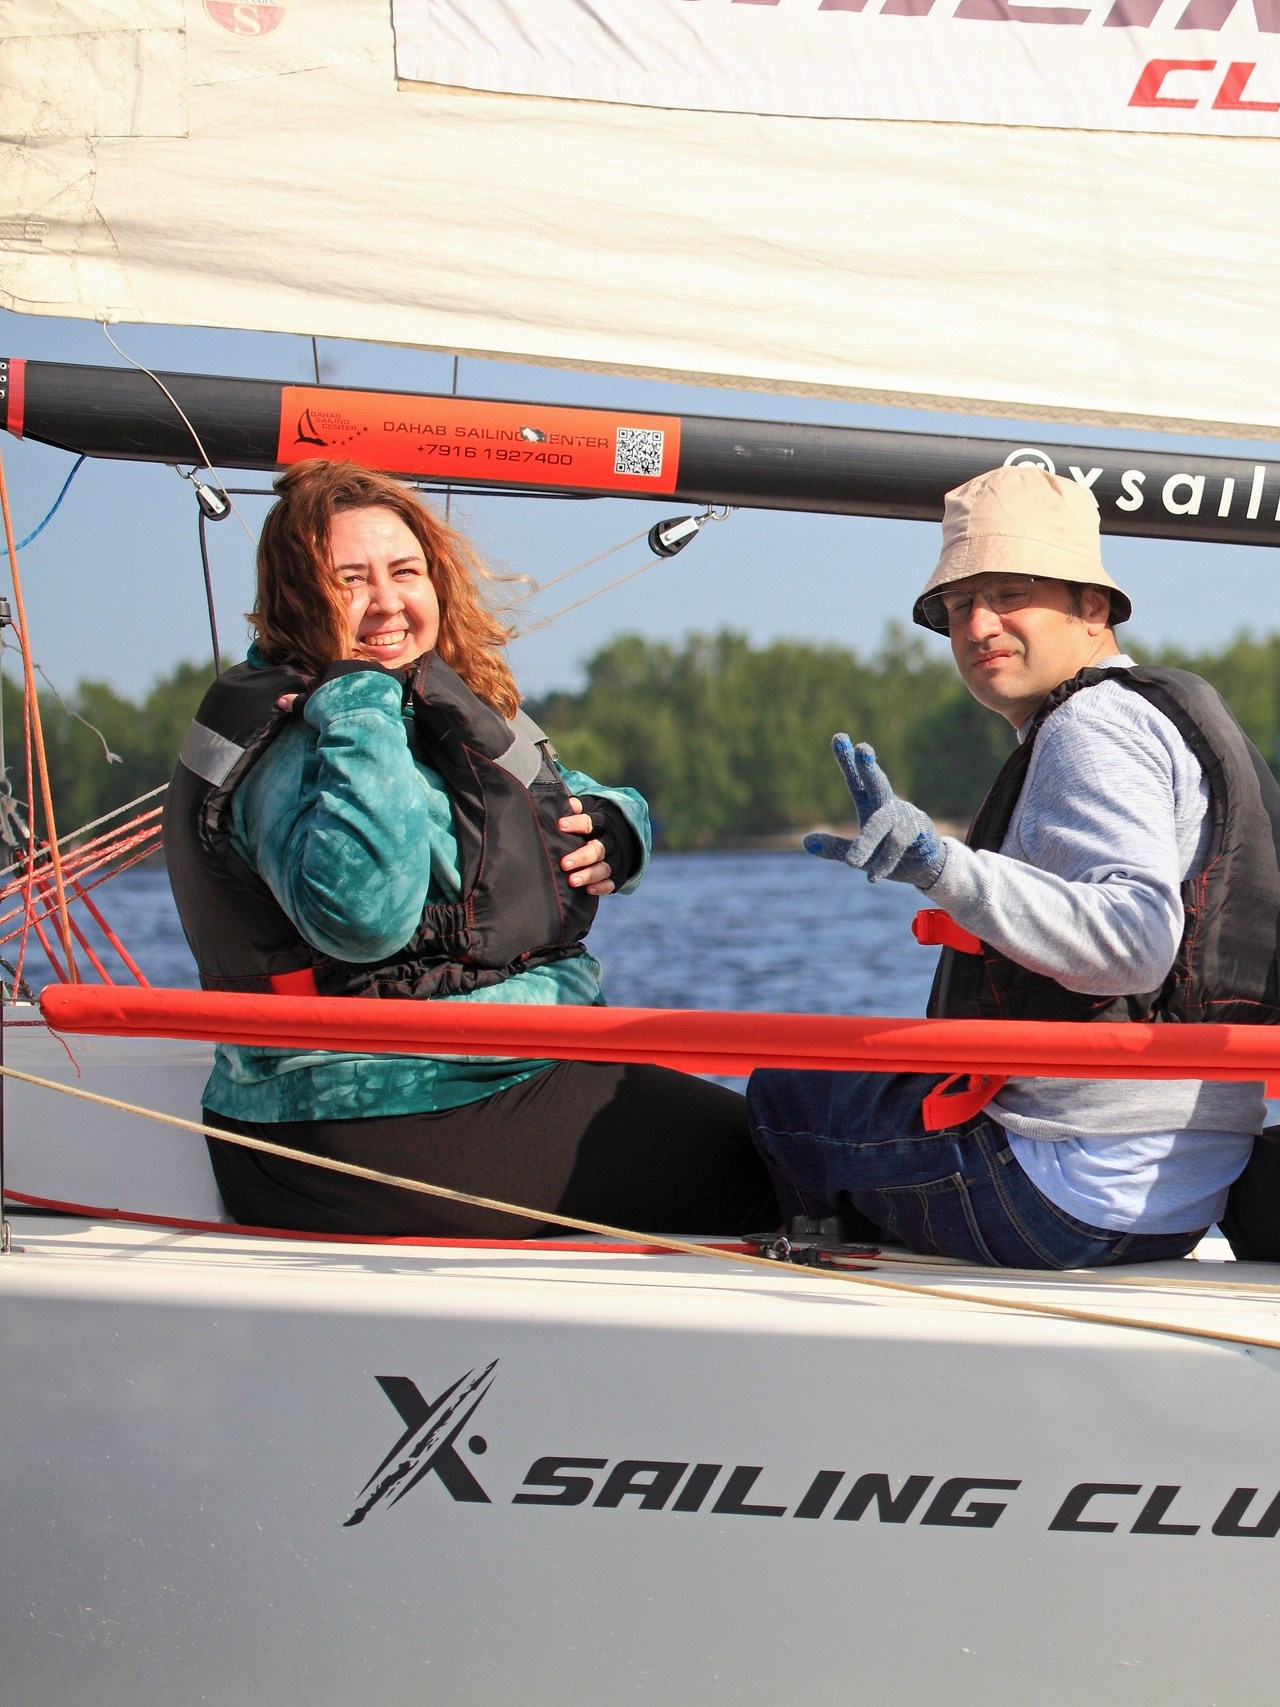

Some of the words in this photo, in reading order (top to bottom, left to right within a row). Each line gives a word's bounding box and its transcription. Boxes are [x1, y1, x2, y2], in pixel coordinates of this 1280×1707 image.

[321, 423, 358, 431] CENTER
[383, 421, 446, 436] DAHAB
[548, 433, 609, 449] ENTER
[417, 443, 477, 459] +7916
[484, 448, 573, 467] 1927400
[511, 1456, 1023, 1529] SAILING
